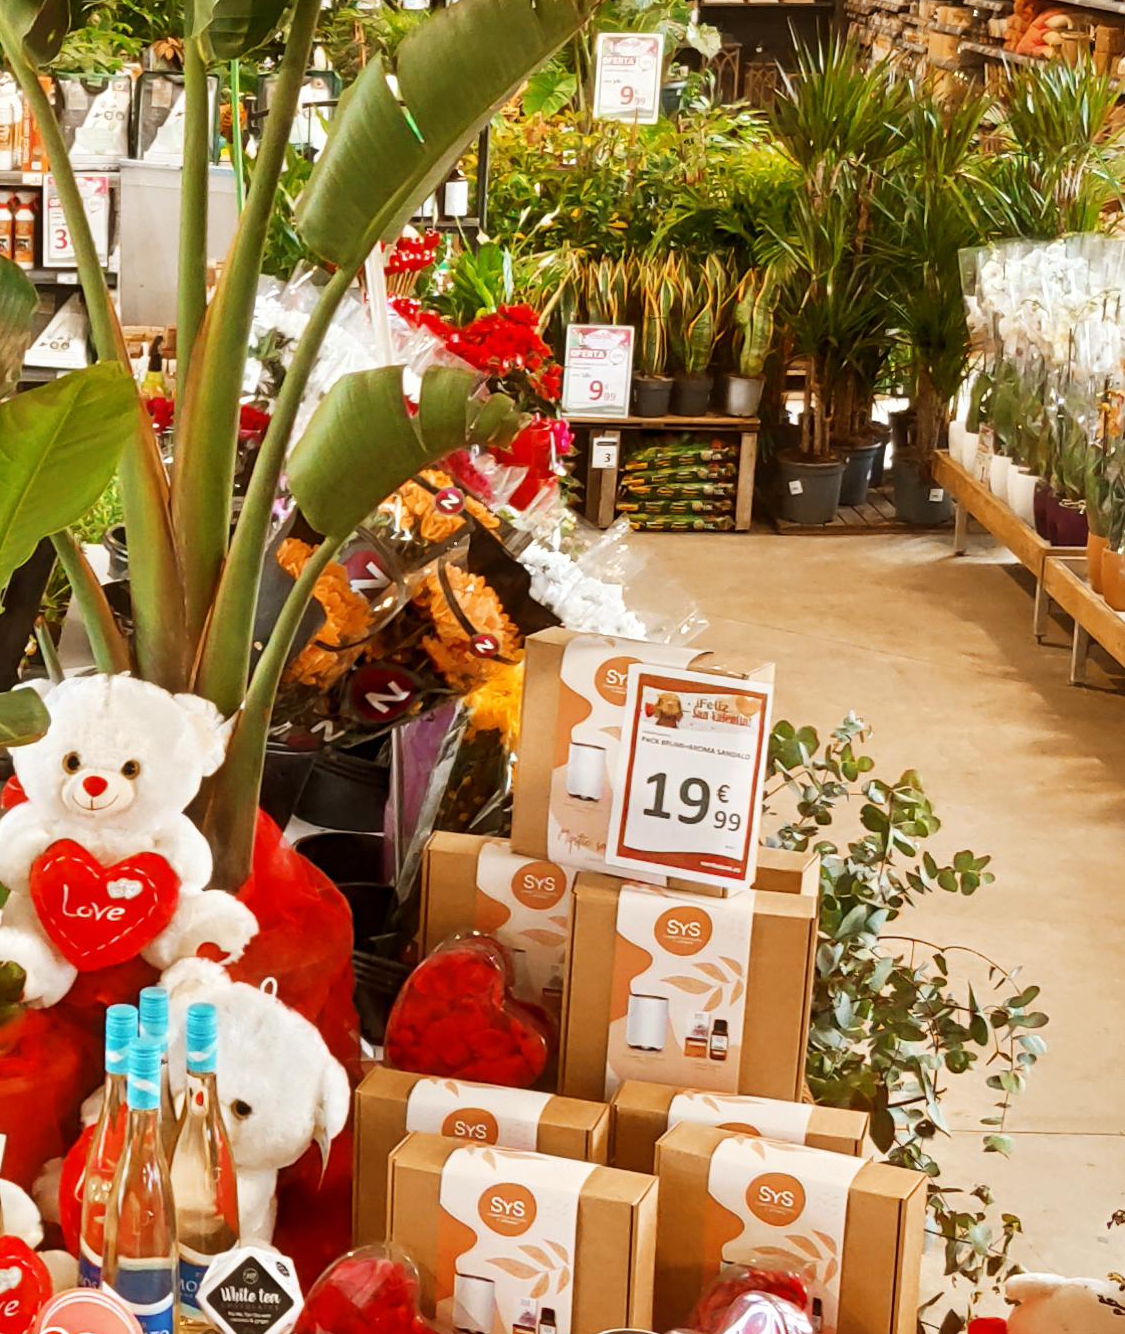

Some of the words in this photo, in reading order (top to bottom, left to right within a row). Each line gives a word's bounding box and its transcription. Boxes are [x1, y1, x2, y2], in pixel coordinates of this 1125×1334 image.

[620, 86, 634, 105] 9
[589, 380, 603, 401] 9
[605, 669, 628, 686] SY
[643, 772, 711, 825] 19
[716, 784, 731, 804] €
[713, 810, 741, 832] 99
[62, 883, 126, 922] Love
[220, 1285, 257, 1303] White
[258, 1288, 281, 1305] tea
